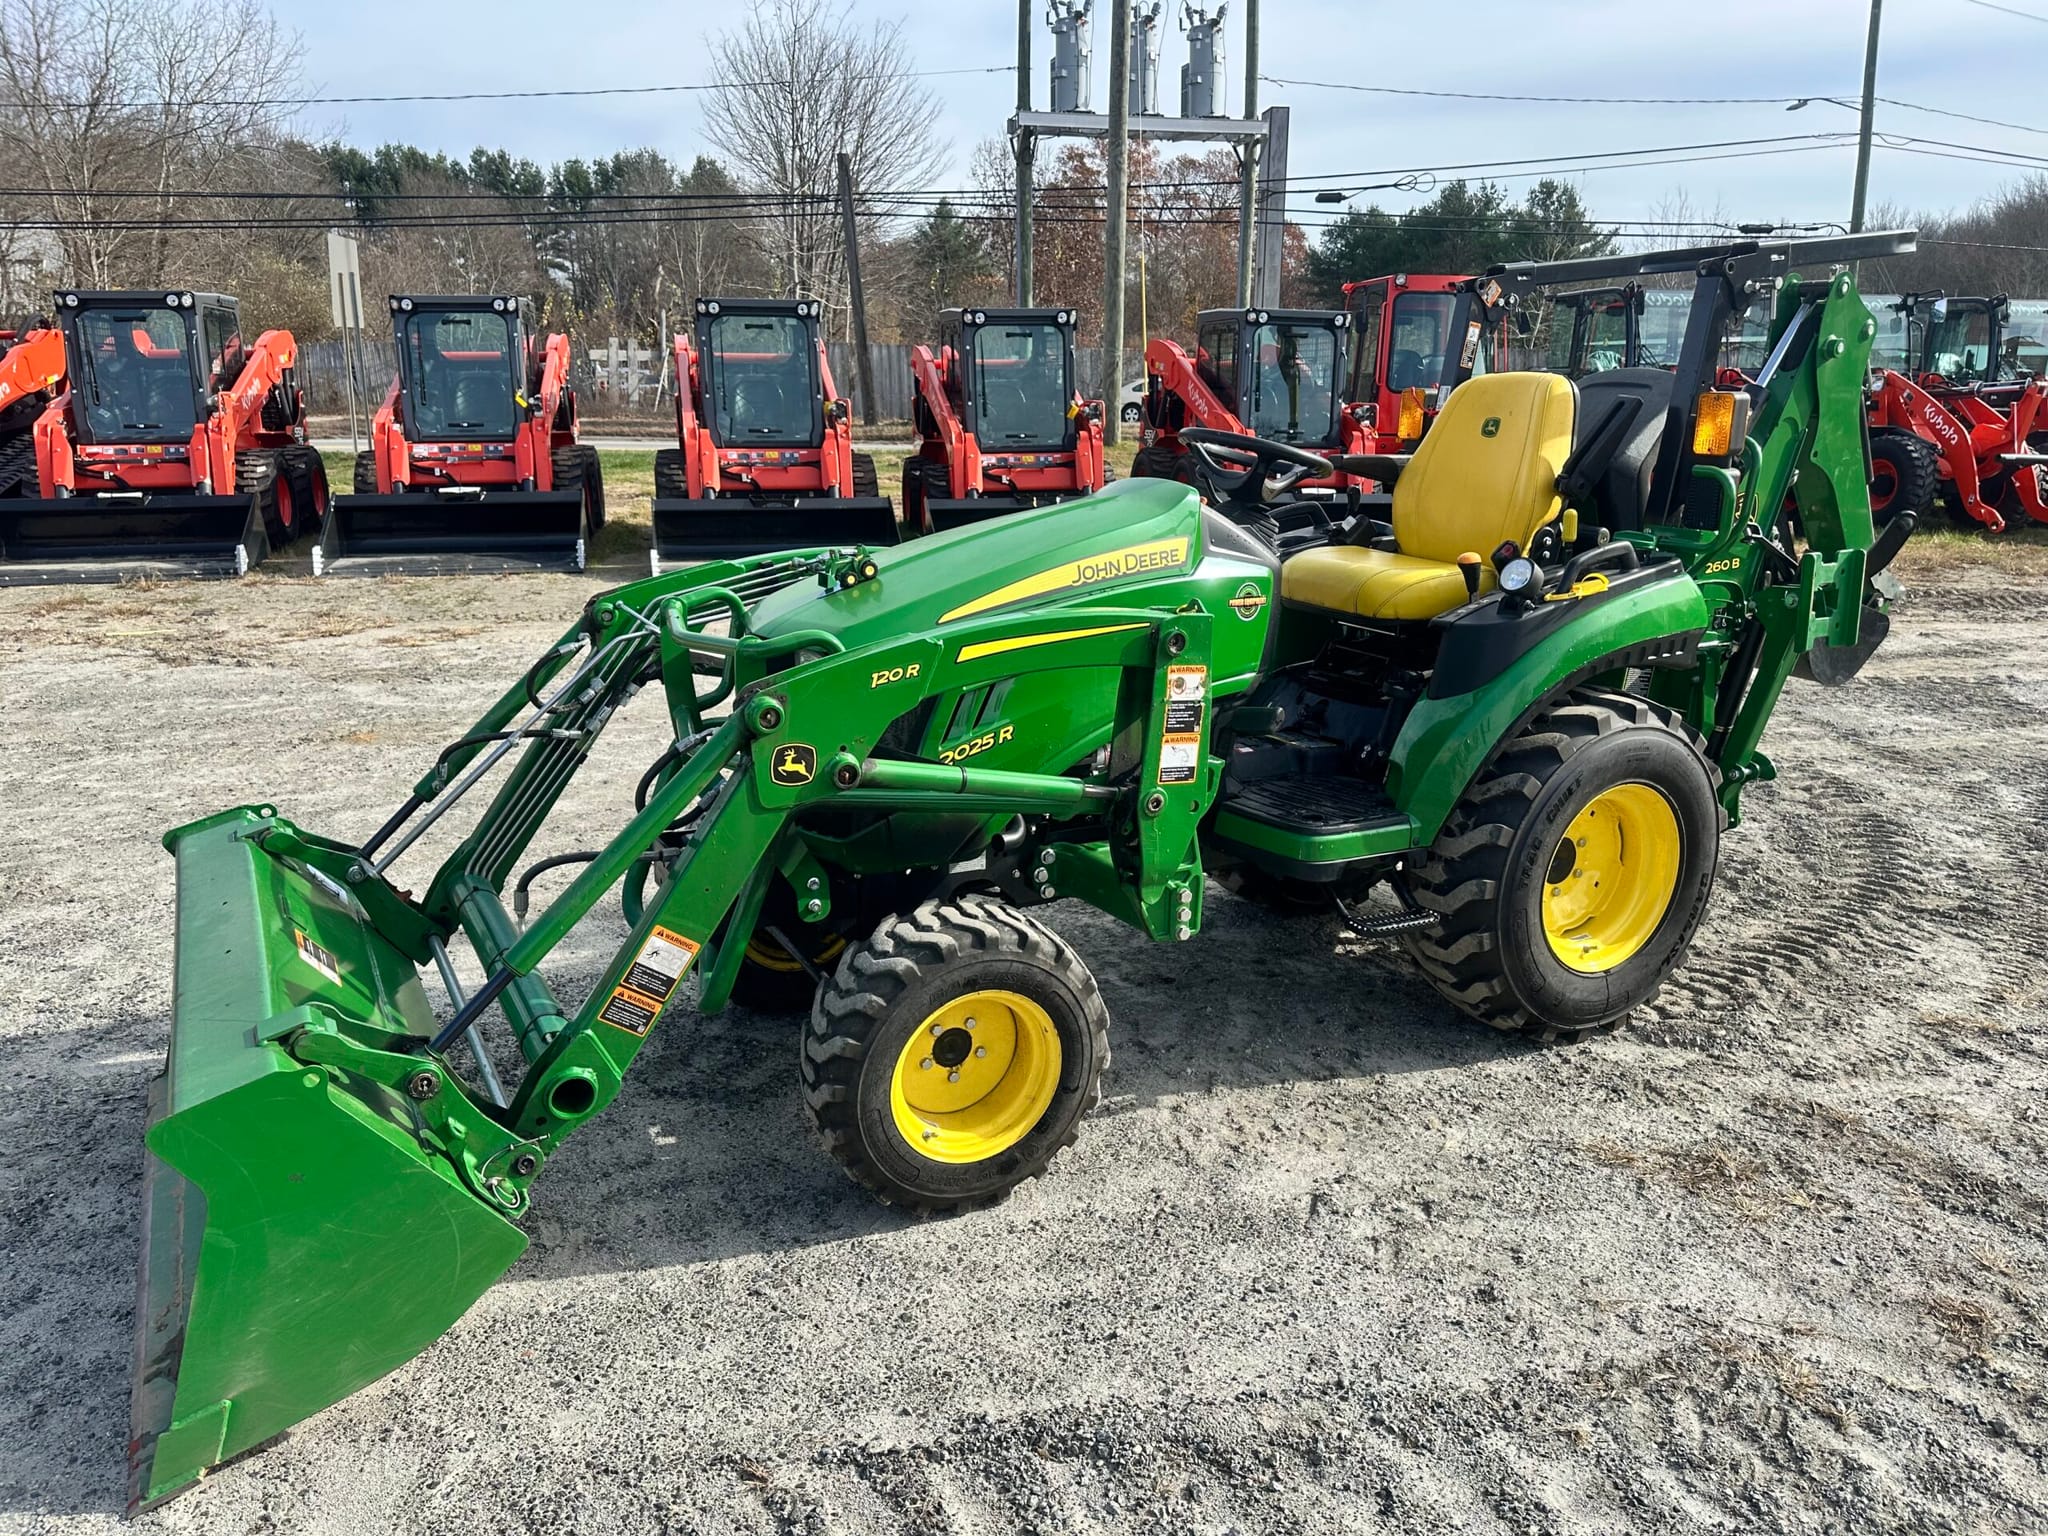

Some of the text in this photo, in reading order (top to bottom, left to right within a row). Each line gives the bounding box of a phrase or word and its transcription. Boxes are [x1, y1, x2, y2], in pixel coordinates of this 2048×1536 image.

[1188, 380, 1208, 419] Kubota
[1924, 403, 1958, 445] Kubota
[1071, 548, 1180, 585] JOHN DEERE
[1705, 558, 1740, 574] 260 B
[871, 663, 921, 688] 120 R
[939, 725, 1015, 766] 2025 R
[1169, 736, 1199, 744] WARNING
[664, 932, 695, 950] WARNING
[626, 993, 657, 1010] WARNING
